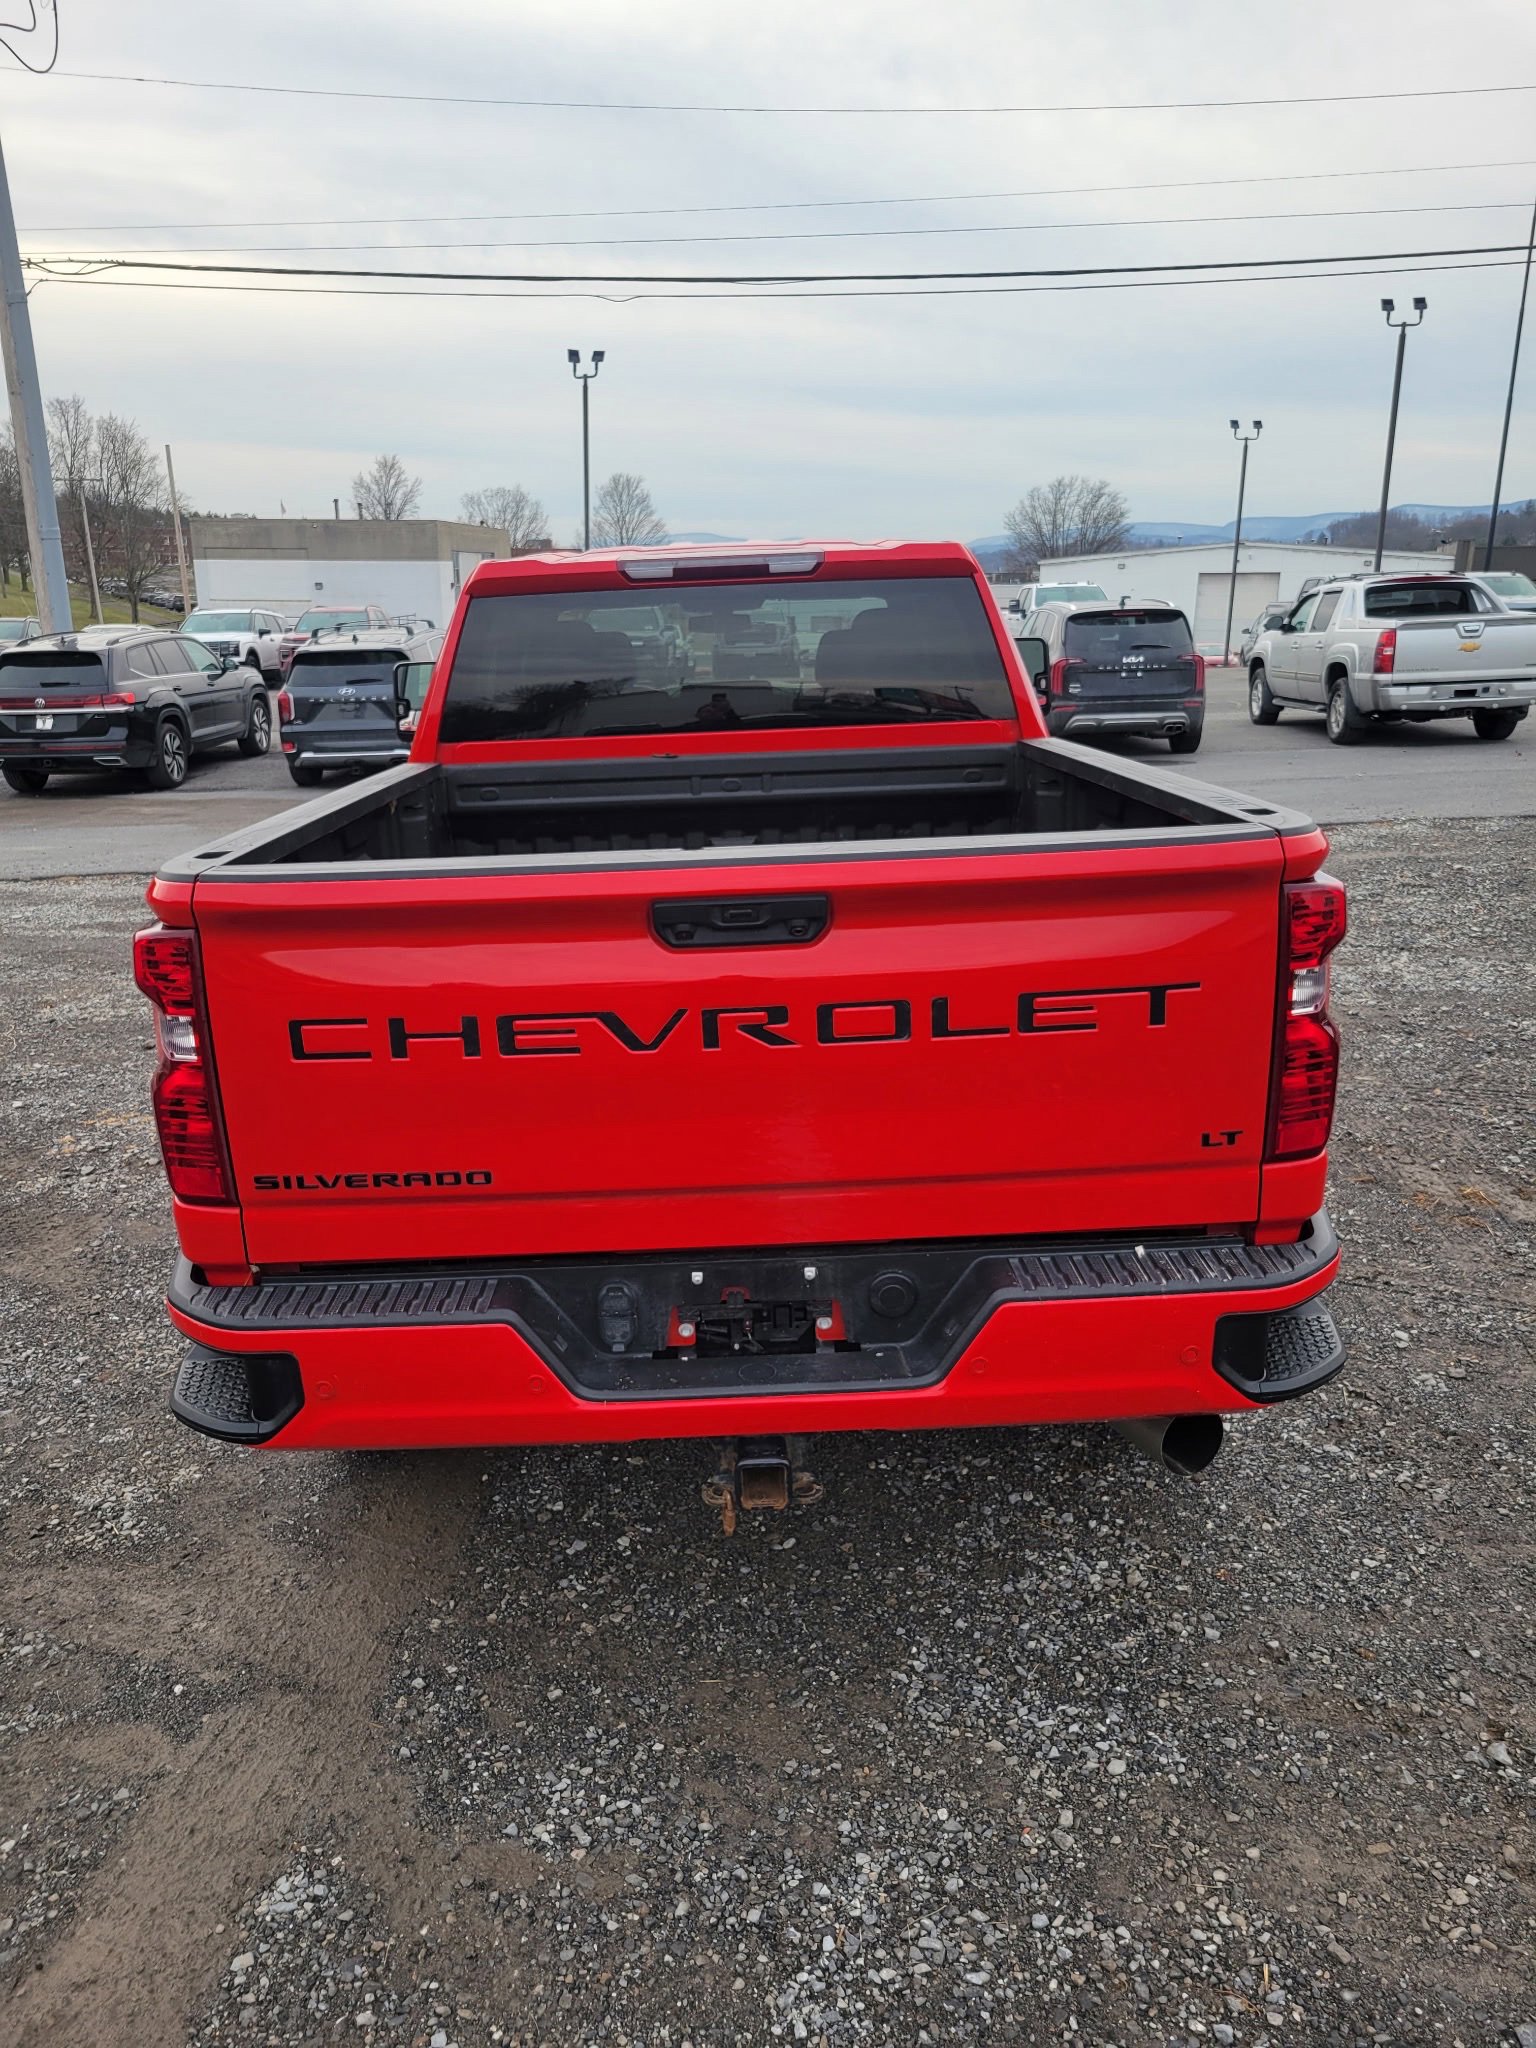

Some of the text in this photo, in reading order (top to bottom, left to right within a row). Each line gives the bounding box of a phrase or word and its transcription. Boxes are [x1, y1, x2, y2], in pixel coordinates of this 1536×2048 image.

[288, 981, 1201, 1061] CHEVROLET
[1201, 1130, 1243, 1147] LT
[253, 1170, 493, 1190] SILVERADO
